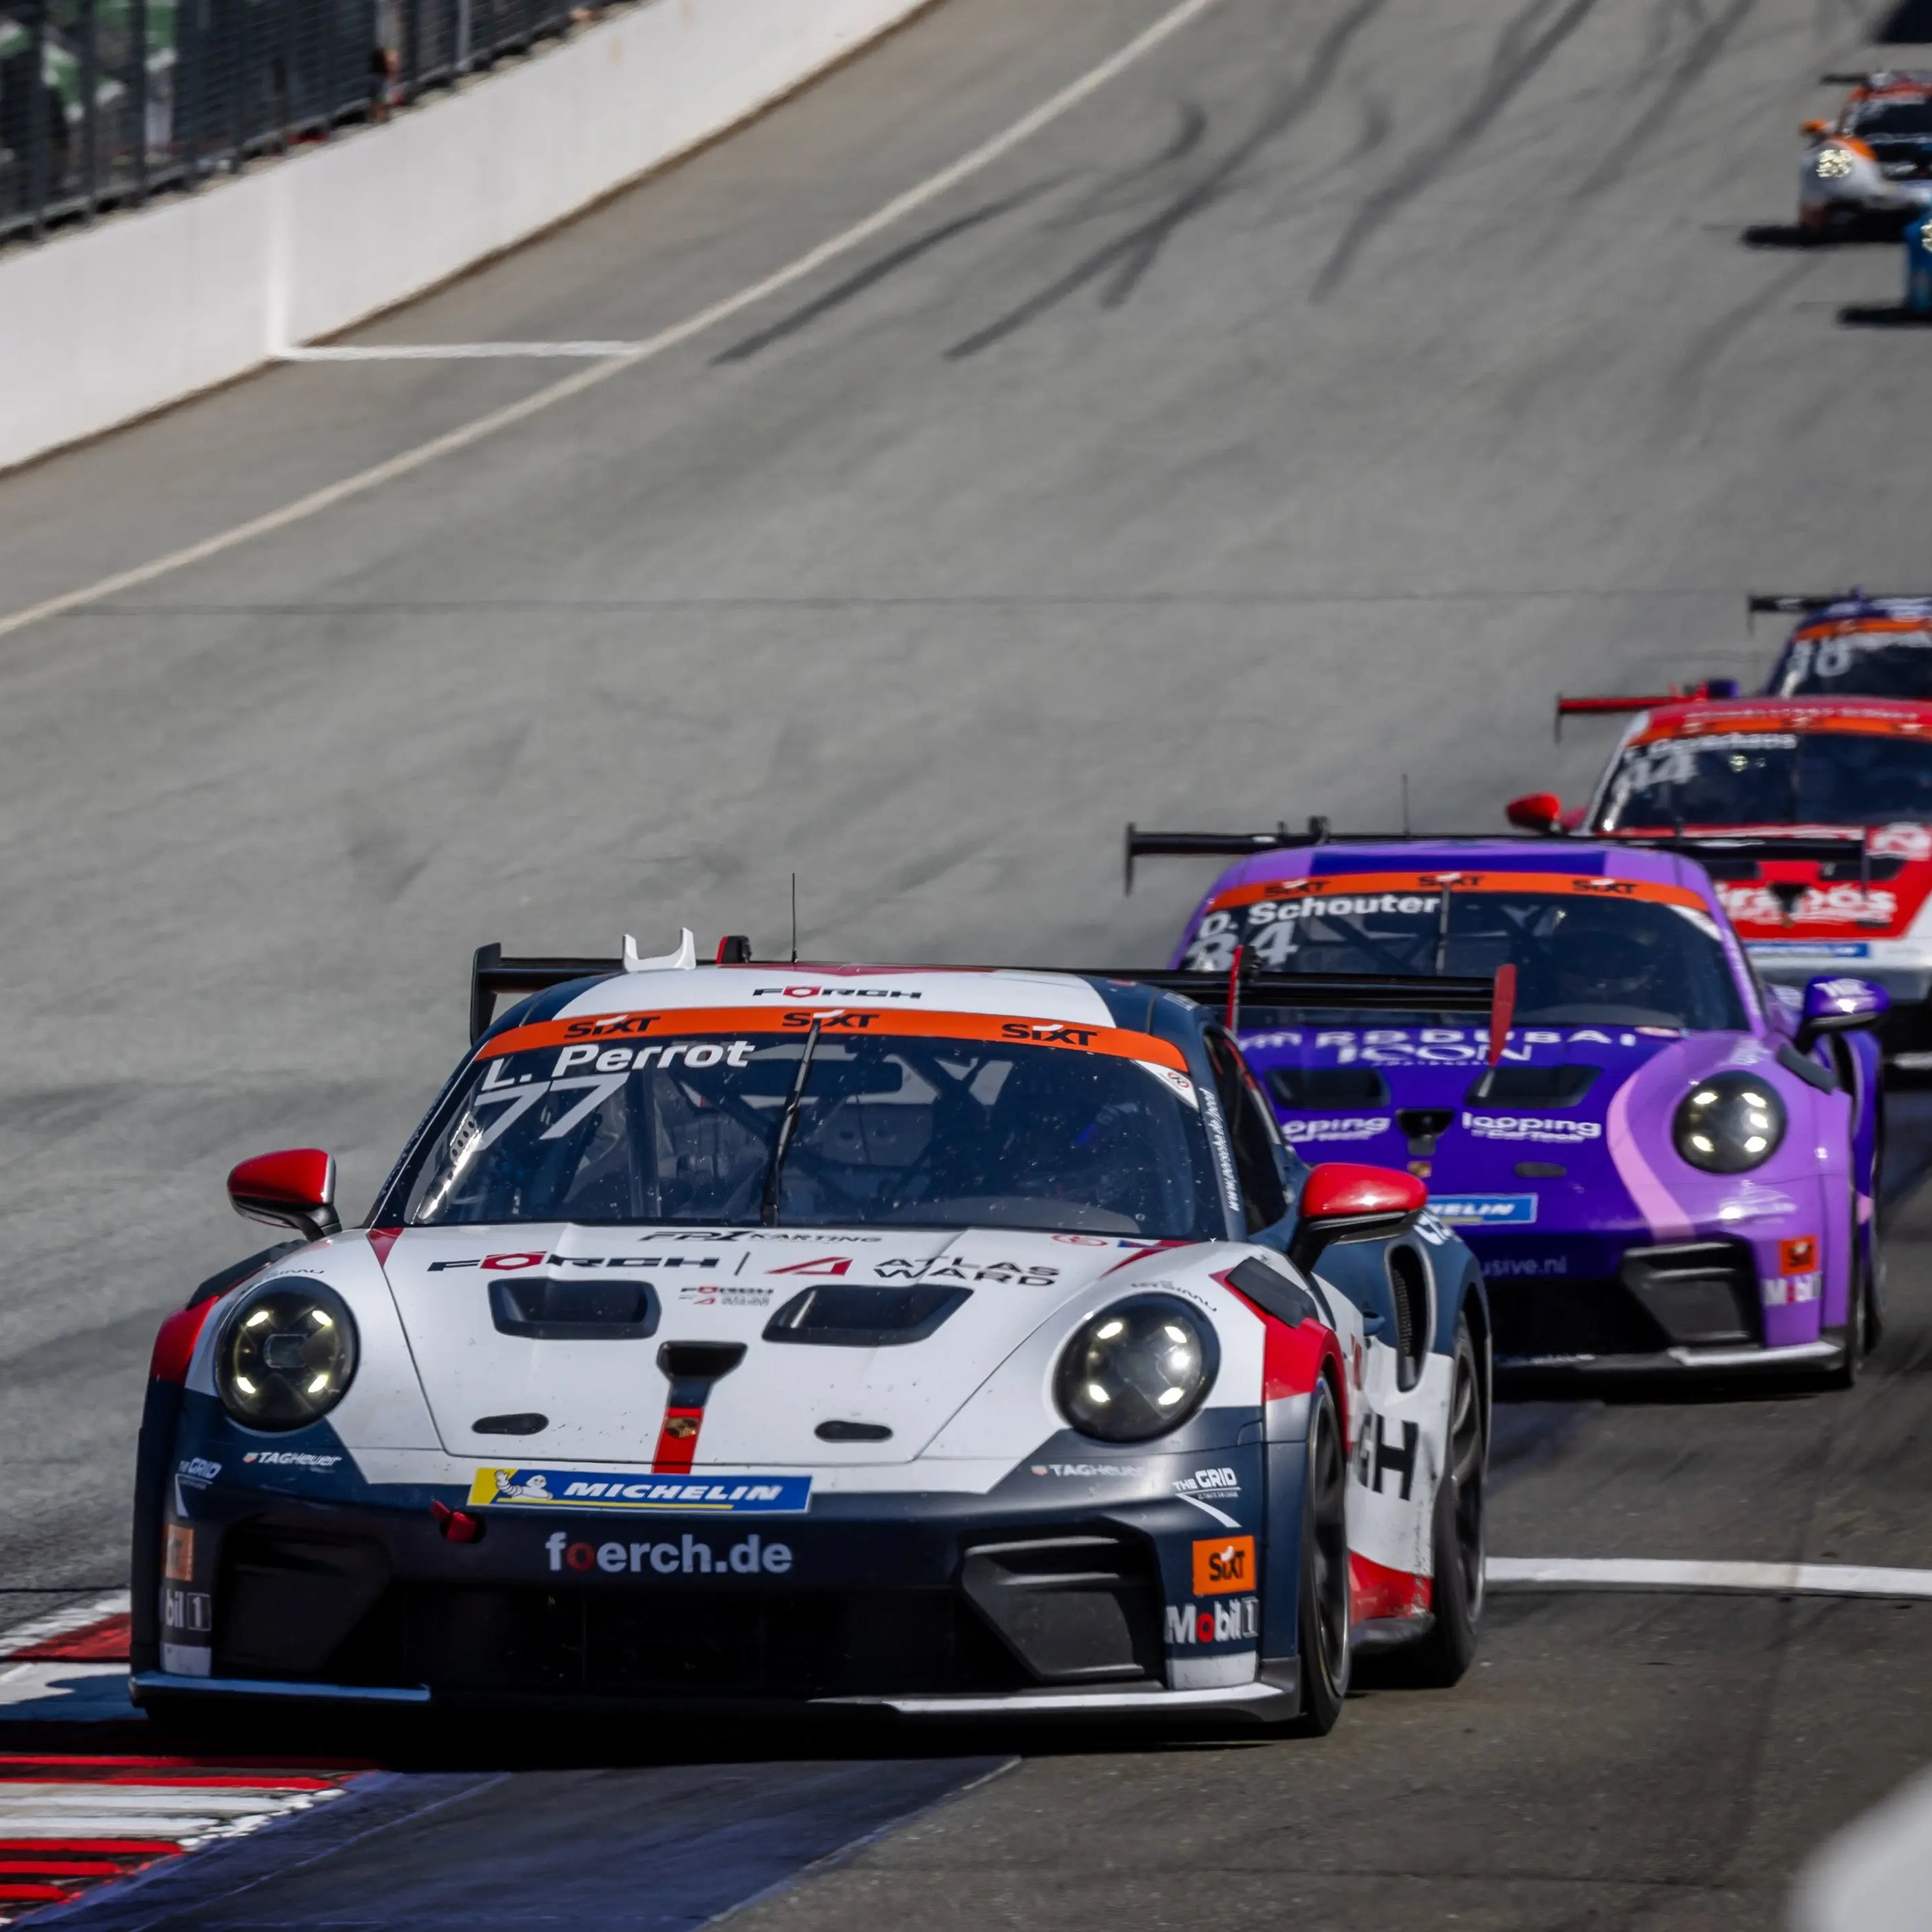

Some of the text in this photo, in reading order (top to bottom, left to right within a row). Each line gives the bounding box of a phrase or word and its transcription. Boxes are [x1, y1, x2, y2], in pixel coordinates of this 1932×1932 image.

[481, 1040, 755, 1092] L. Perrot
[474, 1071, 631, 1152] 77
[1462, 1111, 1602, 1139] looping
[873, 1268, 1056, 1286] WARD
[874, 1255, 1060, 1277] ATLAS
[563, 1480, 783, 1502] MICHELIN
[1194, 1467, 1237, 1489] GRID
[545, 1531, 793, 1574] foerch.de
[165, 1588, 184, 1628] bil
